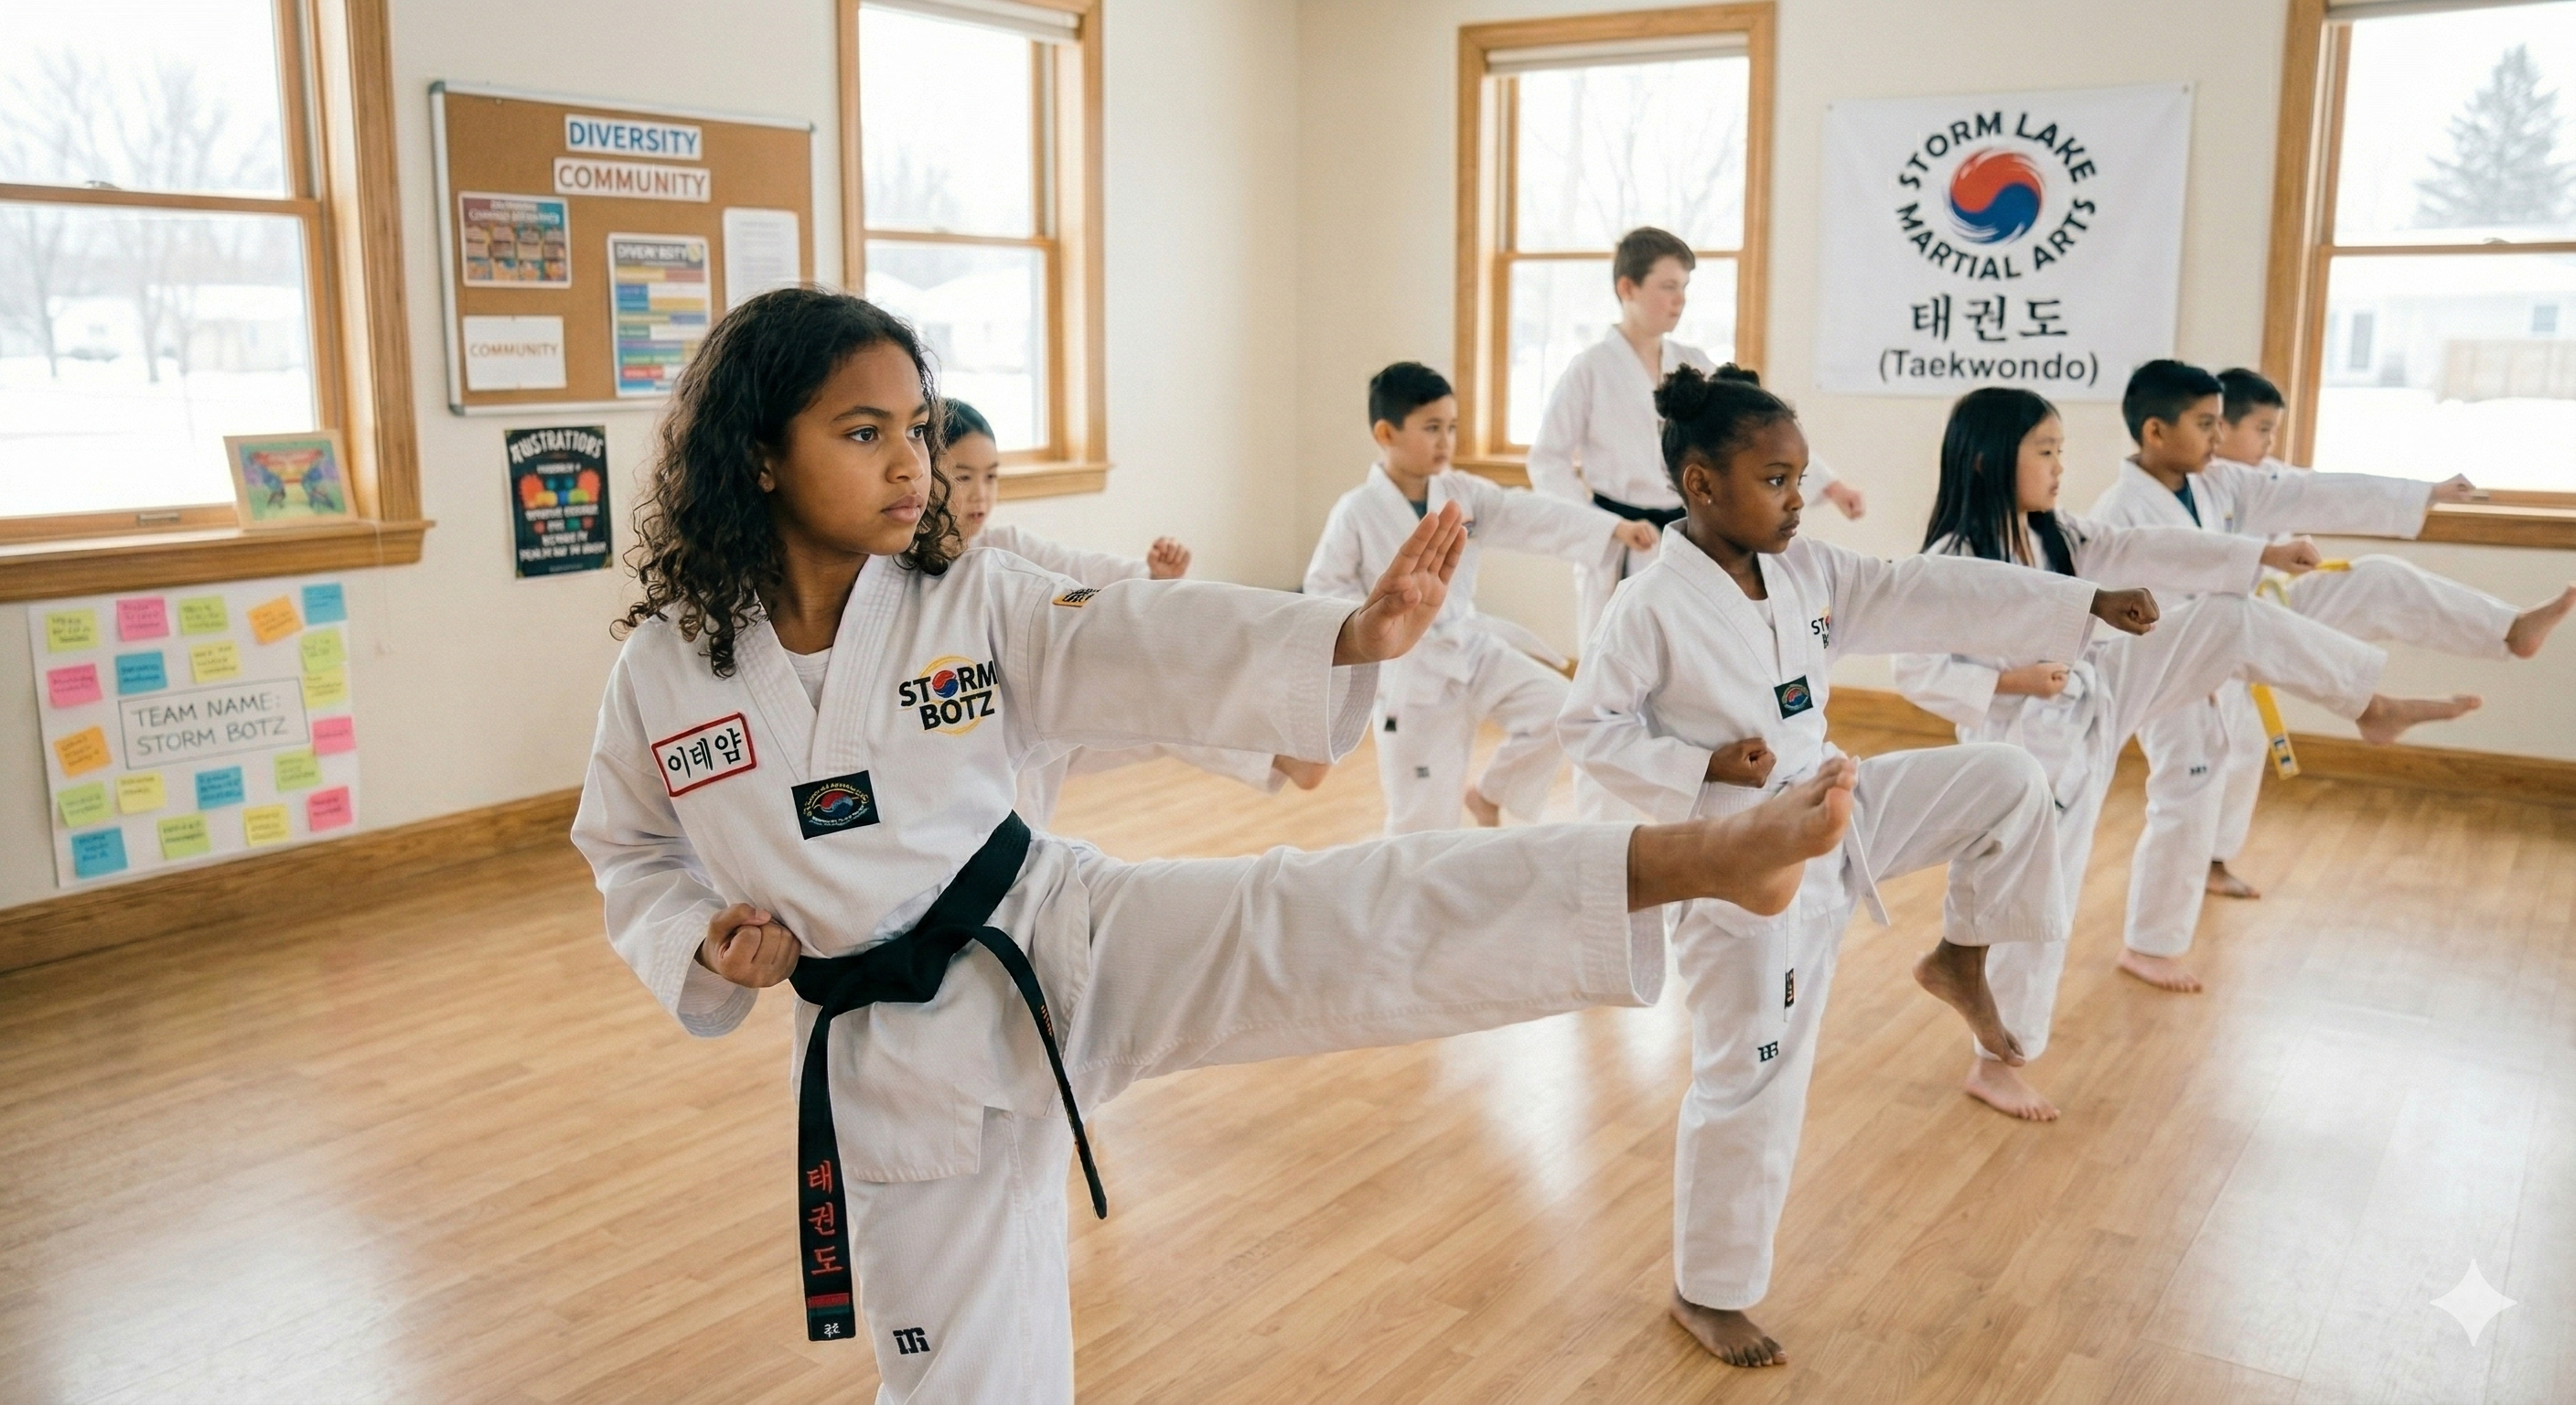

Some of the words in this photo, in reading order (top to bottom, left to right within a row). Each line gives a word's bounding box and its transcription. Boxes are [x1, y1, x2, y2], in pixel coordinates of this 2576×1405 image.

[569, 122, 697, 155] DIVERSITY
[1898, 111, 2003, 190] STORM
[2015, 113, 2097, 183] LAKE
[559, 165, 705, 196] COMMUNITY
[1896, 202, 2022, 281] MARTIAL
[2033, 196, 2096, 270] ARTS
[1910, 294, 2068, 342] 태권도
[470, 342, 559, 357] COMMUNITY
[1879, 348, 2099, 387] (Taekwondo)
[898, 660, 998, 707] STORM
[130, 704, 198, 729] TEAM
[208, 692, 282, 719] NAME:
[918, 690, 995, 731] BOTZ
[137, 728, 216, 756] STORM
[229, 716, 289, 743] BOTZ
